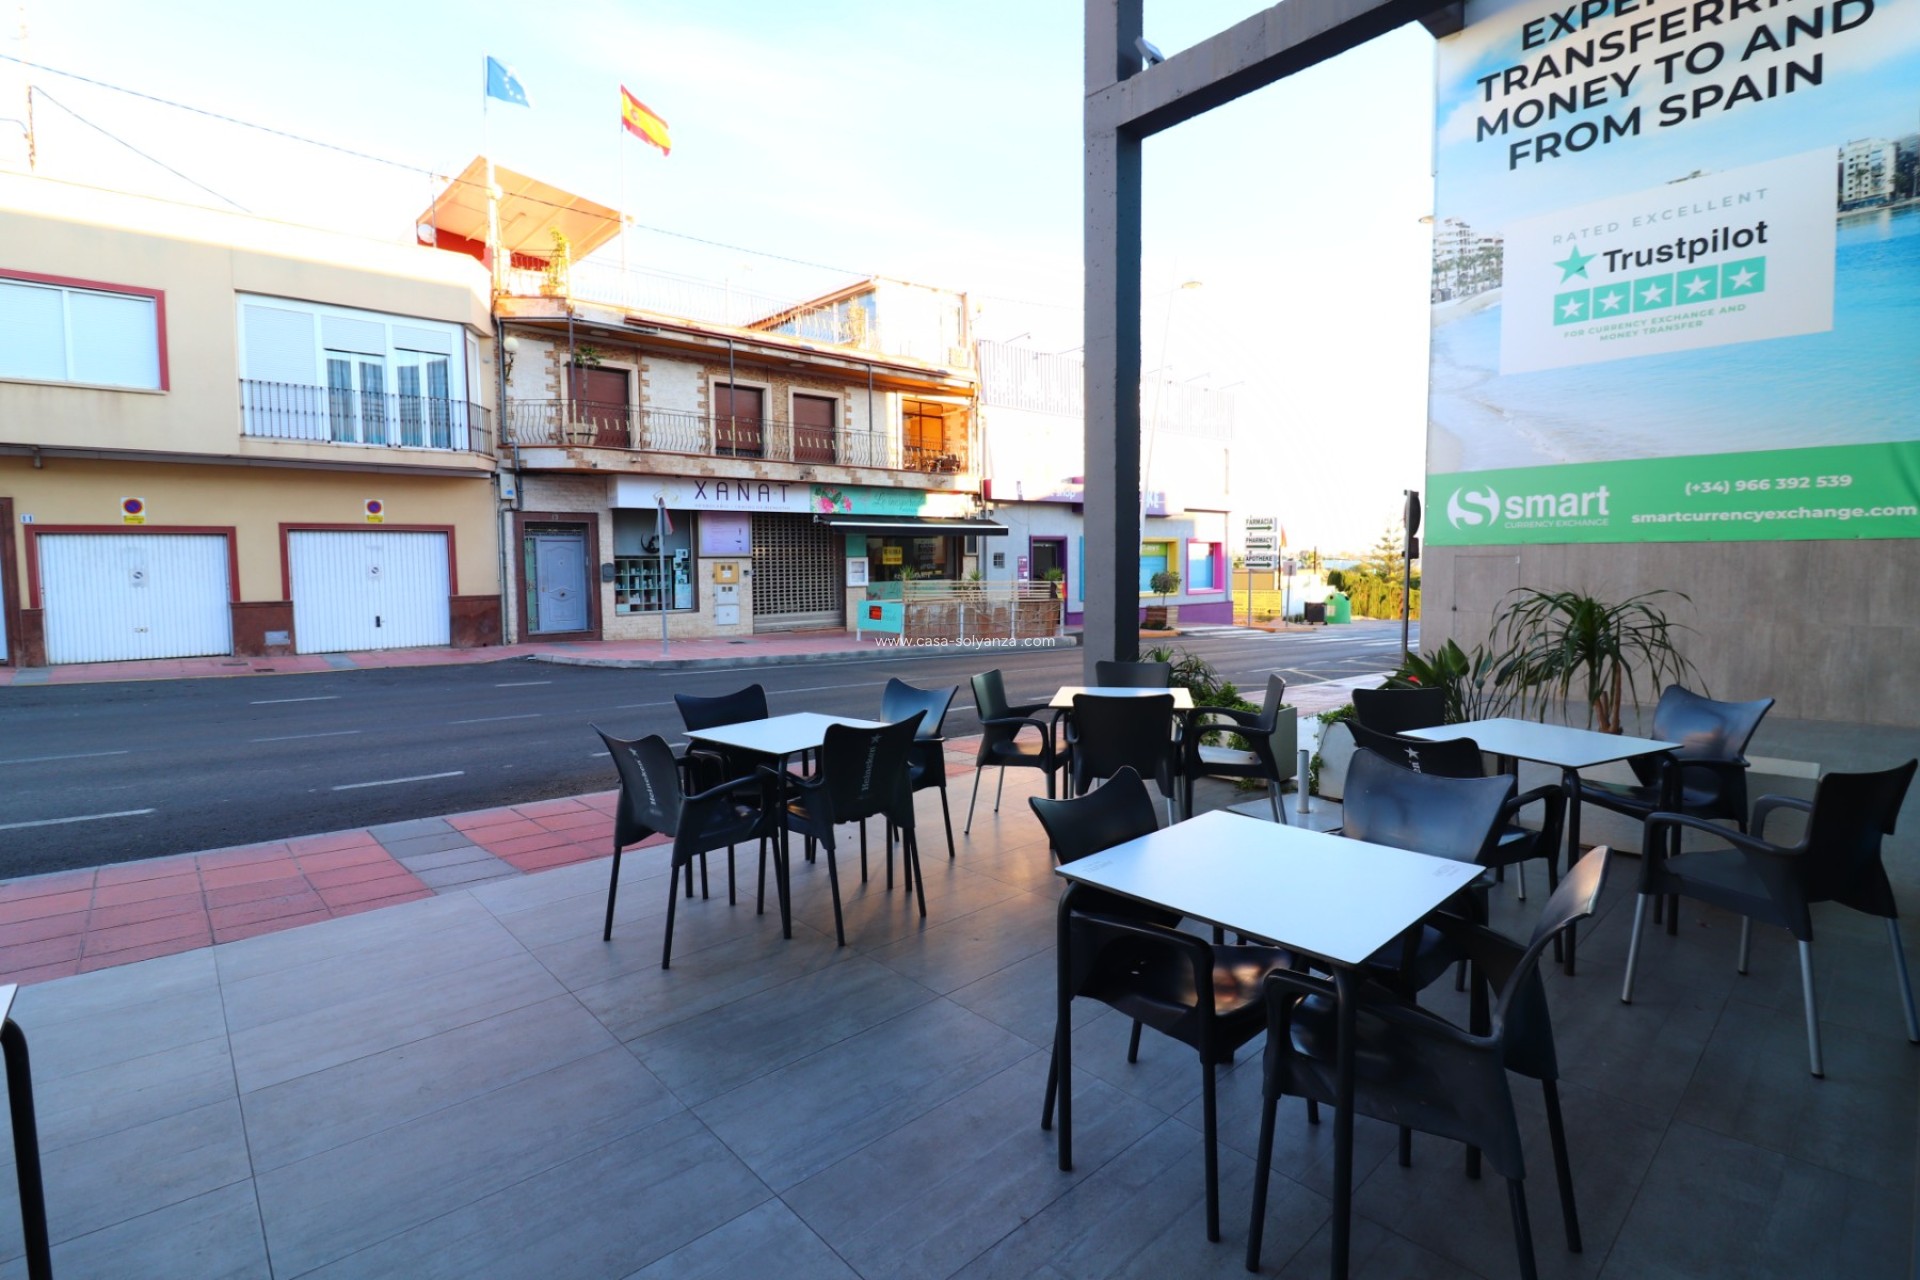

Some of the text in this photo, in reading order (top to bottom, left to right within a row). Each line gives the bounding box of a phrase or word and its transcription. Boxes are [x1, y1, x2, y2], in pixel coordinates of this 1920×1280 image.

[1522, 0, 1655, 51] EXPE
[1476, 0, 1794, 102] TRANSFERR
[1476, 0, 1875, 143] MONEY TO AND
[1509, 53, 1823, 171] FROM SPAIN
[1552, 188, 1768, 245] RATED EXCELLENT
[1603, 221, 1768, 273] Trustpilot
[1563, 303, 1746, 338] FOR CURRENCY EXCHANGE AND
[1600, 319, 1704, 341] MONEY TRANSFER
[694, 480, 791, 502] XANAT
[1504, 485, 1611, 519] smart
[1685, 475, 1853, 496] (+34) 966 392 539
[1504, 518, 1609, 529] CURRENCY EXCHANGE
[1631, 505, 1918, 523] smartcurrencyexchange.com
[860, 744, 877, 791] Heineken
